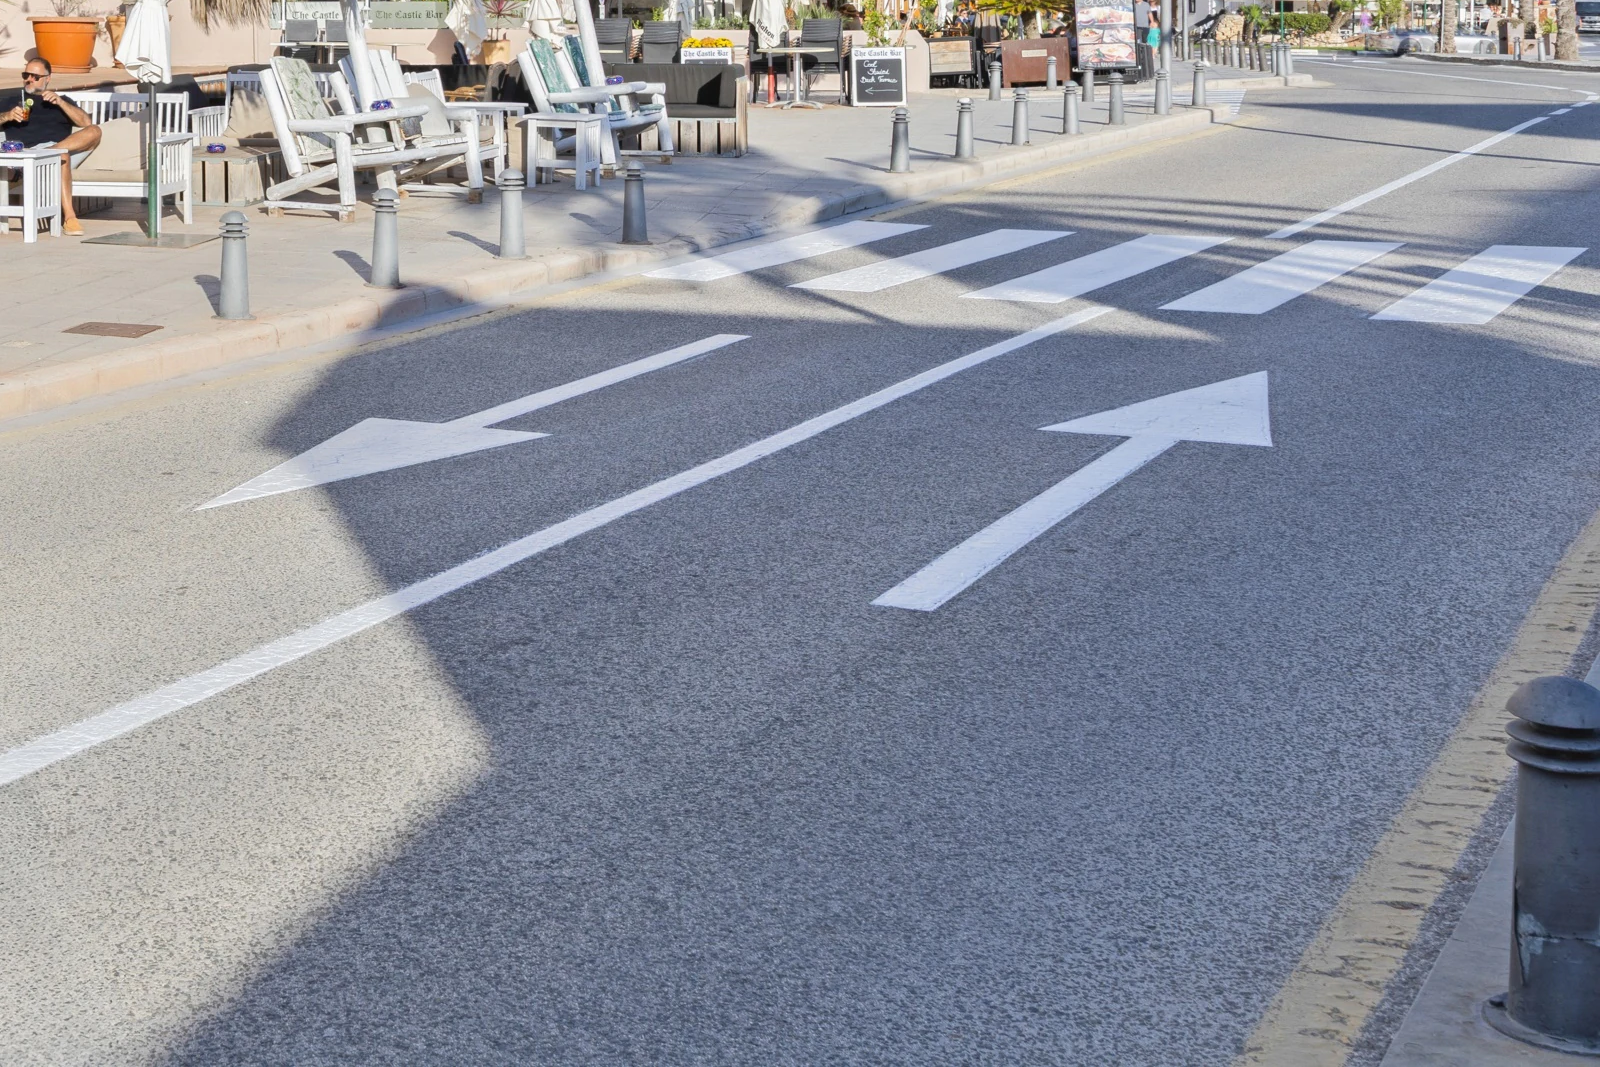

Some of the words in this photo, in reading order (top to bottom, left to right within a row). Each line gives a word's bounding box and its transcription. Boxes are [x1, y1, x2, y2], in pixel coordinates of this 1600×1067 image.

[291, 10, 309, 20] The
[311, 9, 340, 20] Castle
[375, 10, 392, 19] The
[395, 9, 422, 19] Castle
[425, 9, 443, 19] Bar
[683, 50, 695, 58] The
[717, 49, 729, 57] Bar
[853, 49, 867, 58] The
[867, 49, 888, 57] Castle
[890, 49, 902, 57] Bar
